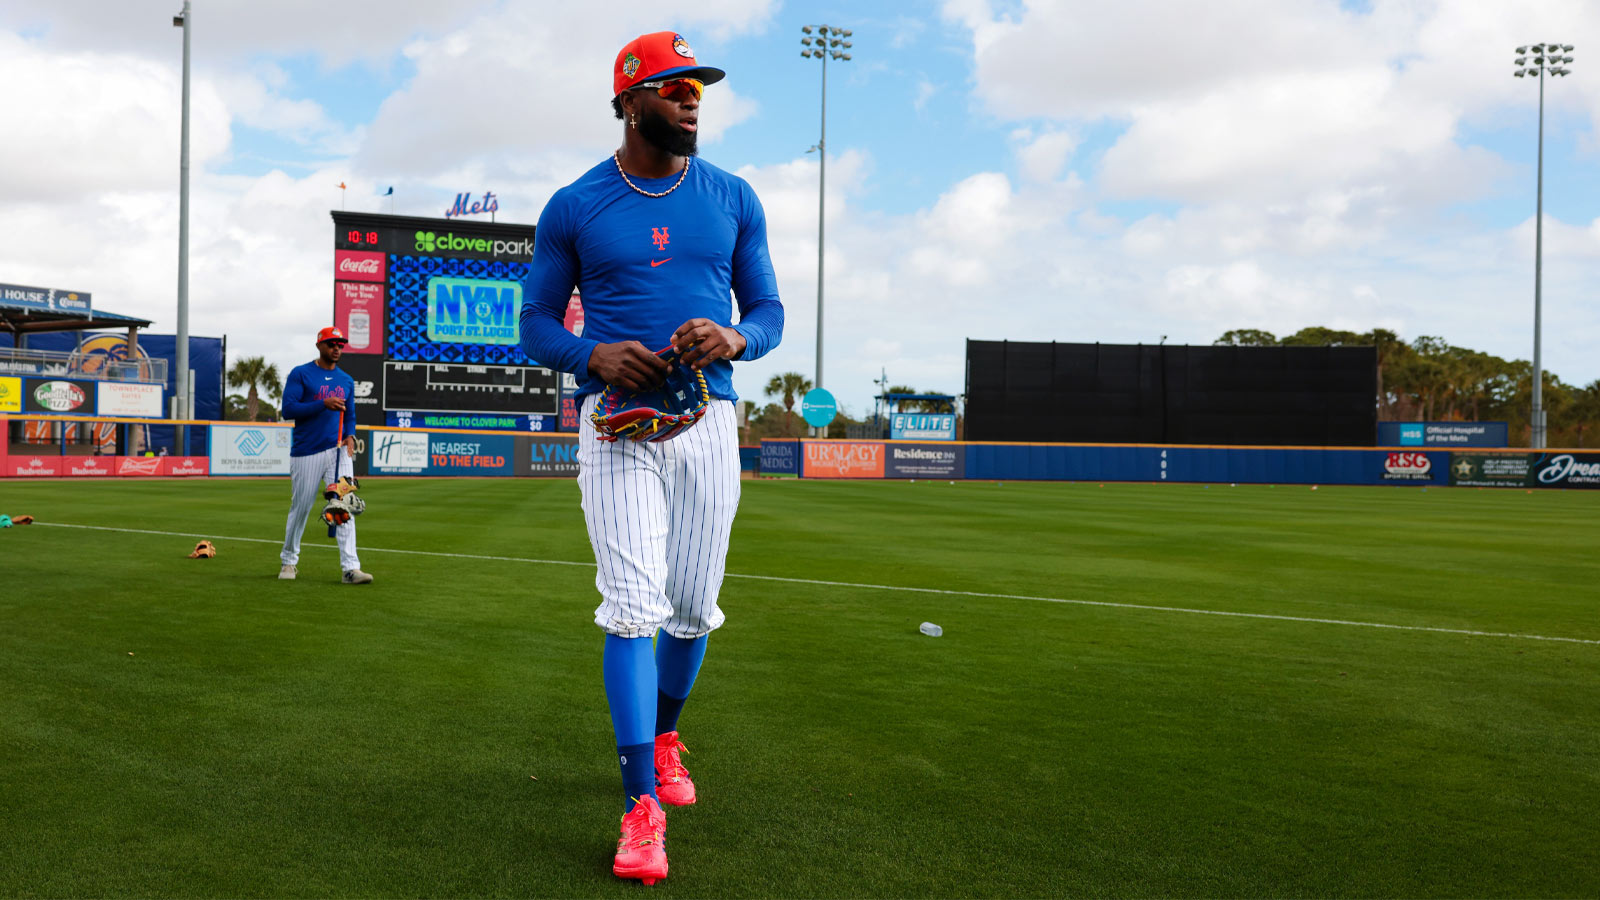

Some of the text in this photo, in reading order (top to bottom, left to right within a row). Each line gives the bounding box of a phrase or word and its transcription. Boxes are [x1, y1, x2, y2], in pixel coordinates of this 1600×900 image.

[446, 191, 499, 217] Mets
[348, 230, 378, 244] 10:18
[342, 283, 379, 292] This Bud's
[5, 289, 45, 303] HOUSE
[59, 296, 87, 309] Corona
[436, 284, 515, 326] NYM
[434, 324, 514, 338] PORT ST. LUCIE
[47, 400, 74, 409] PIZZA
[562, 399, 575, 408] ST
[562, 409, 577, 417] WI
[398, 418, 411, 428] $0
[424, 416, 517, 428] WELCOME TO CLOVER PARK
[529, 421, 542, 431] $0
[894, 416, 952, 430] ELITE
[1427, 426, 1485, 435] Official Hospital
[403, 447, 426, 455] Express
[431, 442, 481, 455] NEAREST
[531, 443, 579, 462] LYNC
[761, 445, 793, 456] LORIDA
[894, 448, 943, 459] Residence
[431, 455, 505, 468] TO THE FIELD
[1387, 452, 1427, 468] RSG
[16, 466, 55, 475] Budweiser
[71, 466, 107, 475] Budweiser
[172, 466, 204, 475] Budweiser
[1538, 454, 1600, 483] Drea
